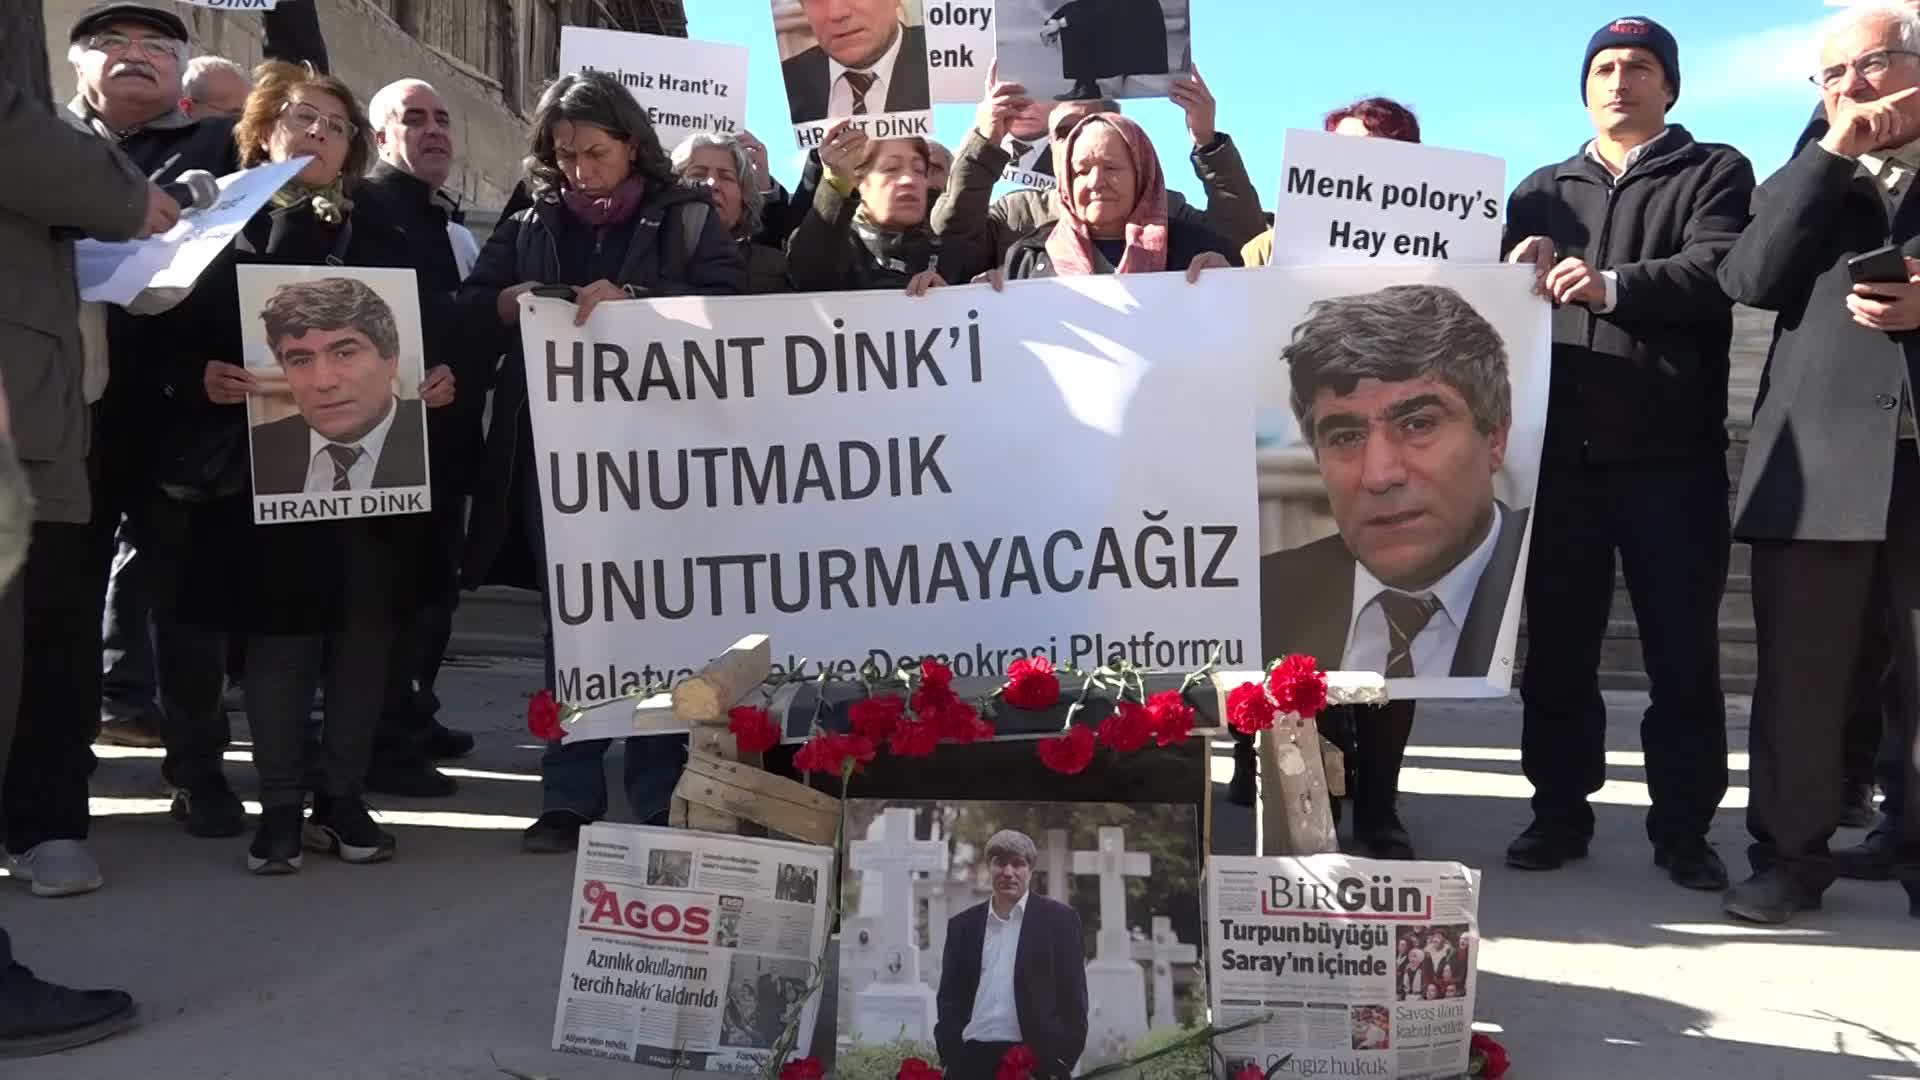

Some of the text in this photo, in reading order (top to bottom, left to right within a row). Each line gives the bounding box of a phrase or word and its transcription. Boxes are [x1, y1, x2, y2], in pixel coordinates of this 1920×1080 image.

[929, 2, 993, 31] olory
[929, 43, 975, 68] enk
[659, 73, 729, 97] Hrant'ız
[647, 107, 736, 133] Ermeni'yiz
[875, 115, 929, 137] DİNK
[1287, 165, 1499, 220] Menk polory's
[1329, 219, 1450, 260] Hay enk
[545, 309, 983, 402] HRANT DİNK'İ
[548, 433, 953, 515] UNUTMADIK
[259, 491, 424, 521] HRANT DİNK
[555, 509, 1240, 626] UNUTTURMAYACAĞIZ
[1070, 631, 1244, 669] Platformu
[1220, 918, 1390, 951] Turpun büyüğü
[586, 949, 708, 981] Azınlık okullarının
[1221, 949, 1388, 979] Saray'ın içinde
[571, 972, 614, 996] 'tercih
[655, 984, 720, 1009] kaldırıldı
[1330, 1055, 1389, 1077] hukuk
